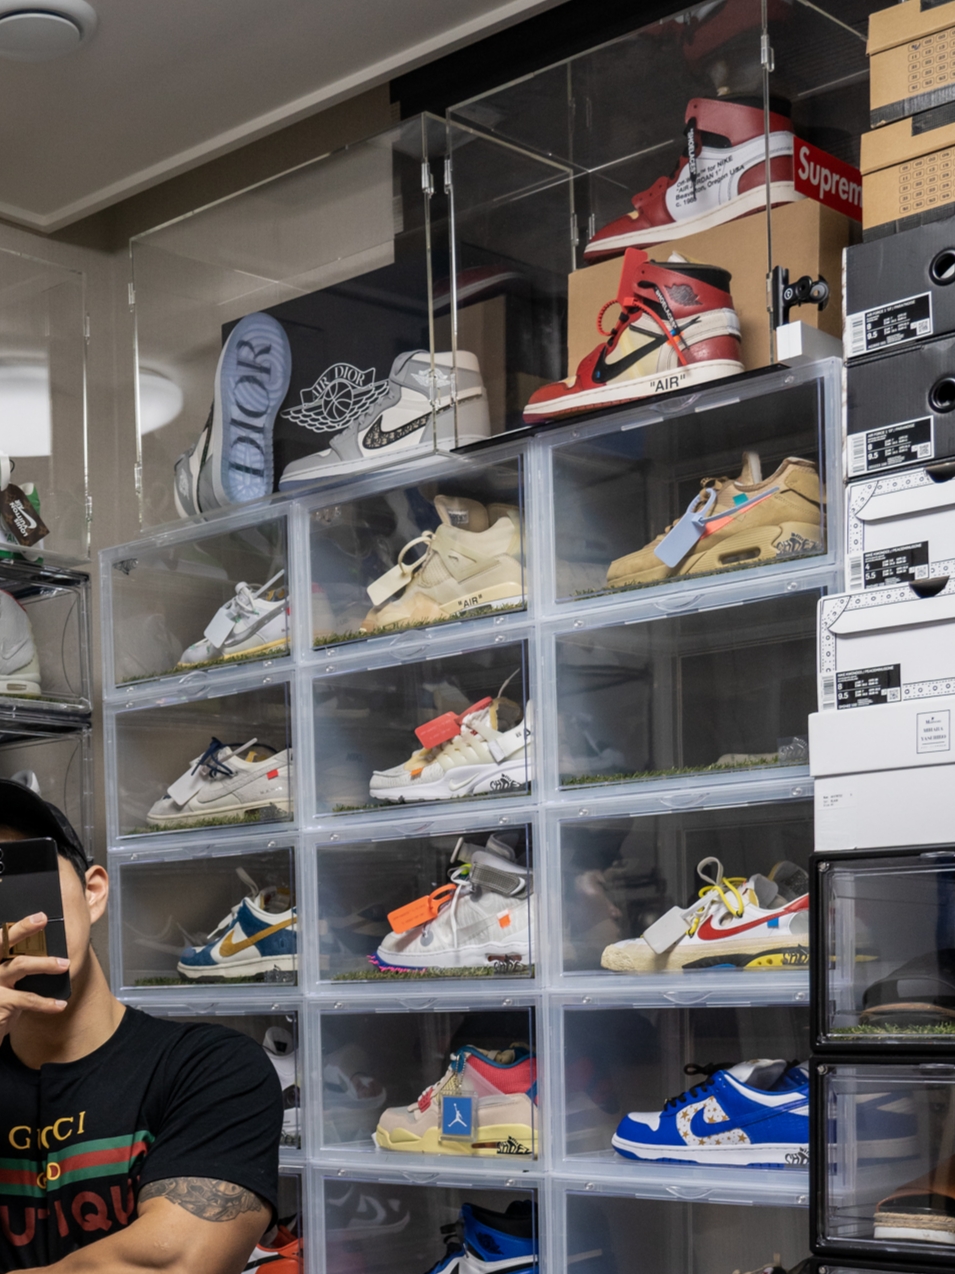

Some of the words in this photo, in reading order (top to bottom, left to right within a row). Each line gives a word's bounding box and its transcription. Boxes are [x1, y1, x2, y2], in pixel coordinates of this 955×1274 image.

[798, 146, 862, 208] Suprem
[312, 376, 330, 398] AIR
[334, 366, 365, 386] DIOR
[650, 374, 686, 392] "AIR"
[229, 340, 272, 477] DIOR
[458, 594, 482, 608] "AIR"
